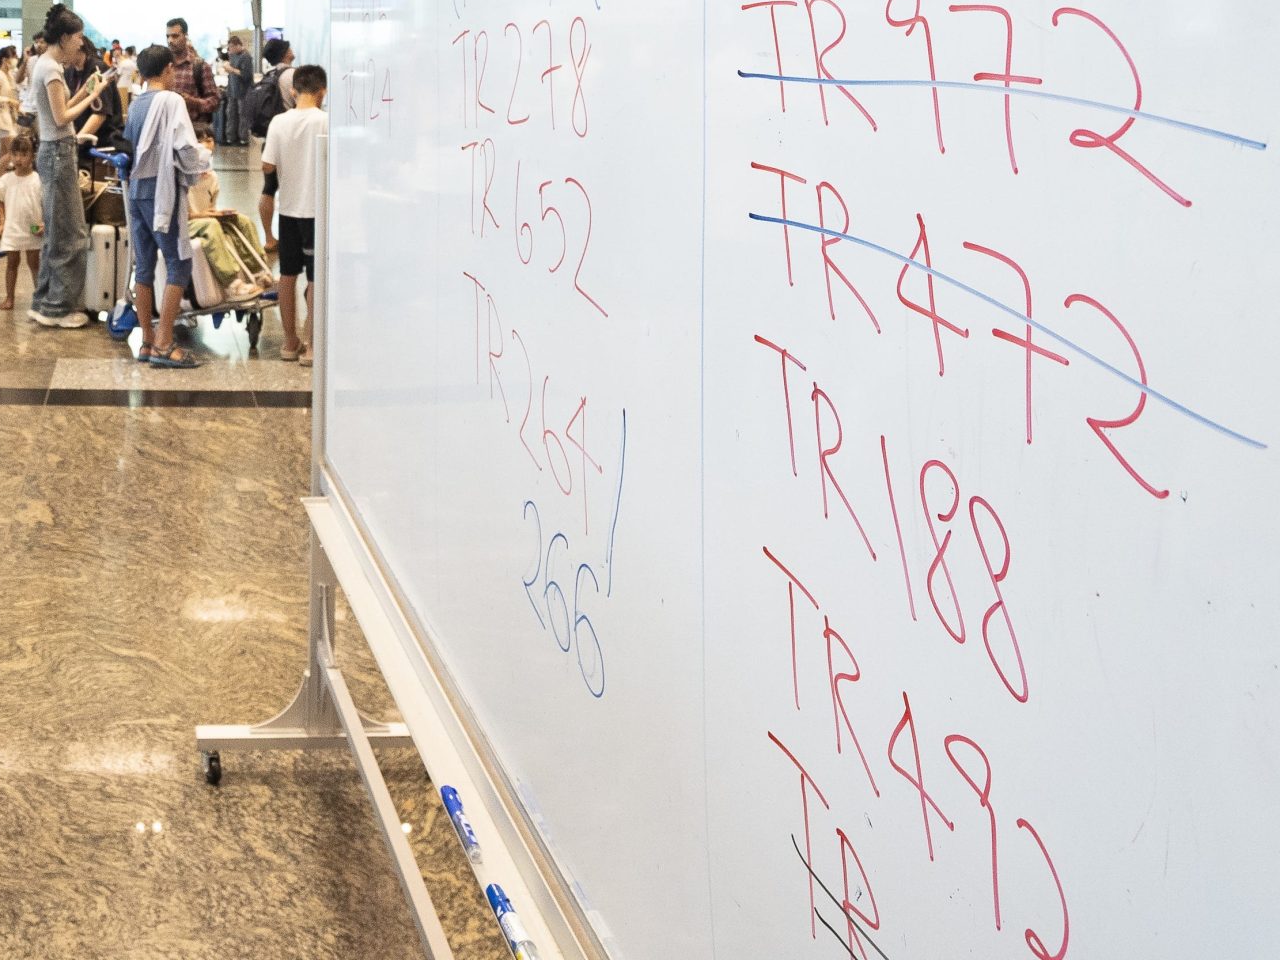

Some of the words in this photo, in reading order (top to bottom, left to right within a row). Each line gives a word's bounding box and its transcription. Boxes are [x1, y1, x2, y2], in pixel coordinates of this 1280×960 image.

[452, 16, 592, 138] TR278
[461, 138, 609, 318] TR652
[754, 334, 1030, 704] TR188
